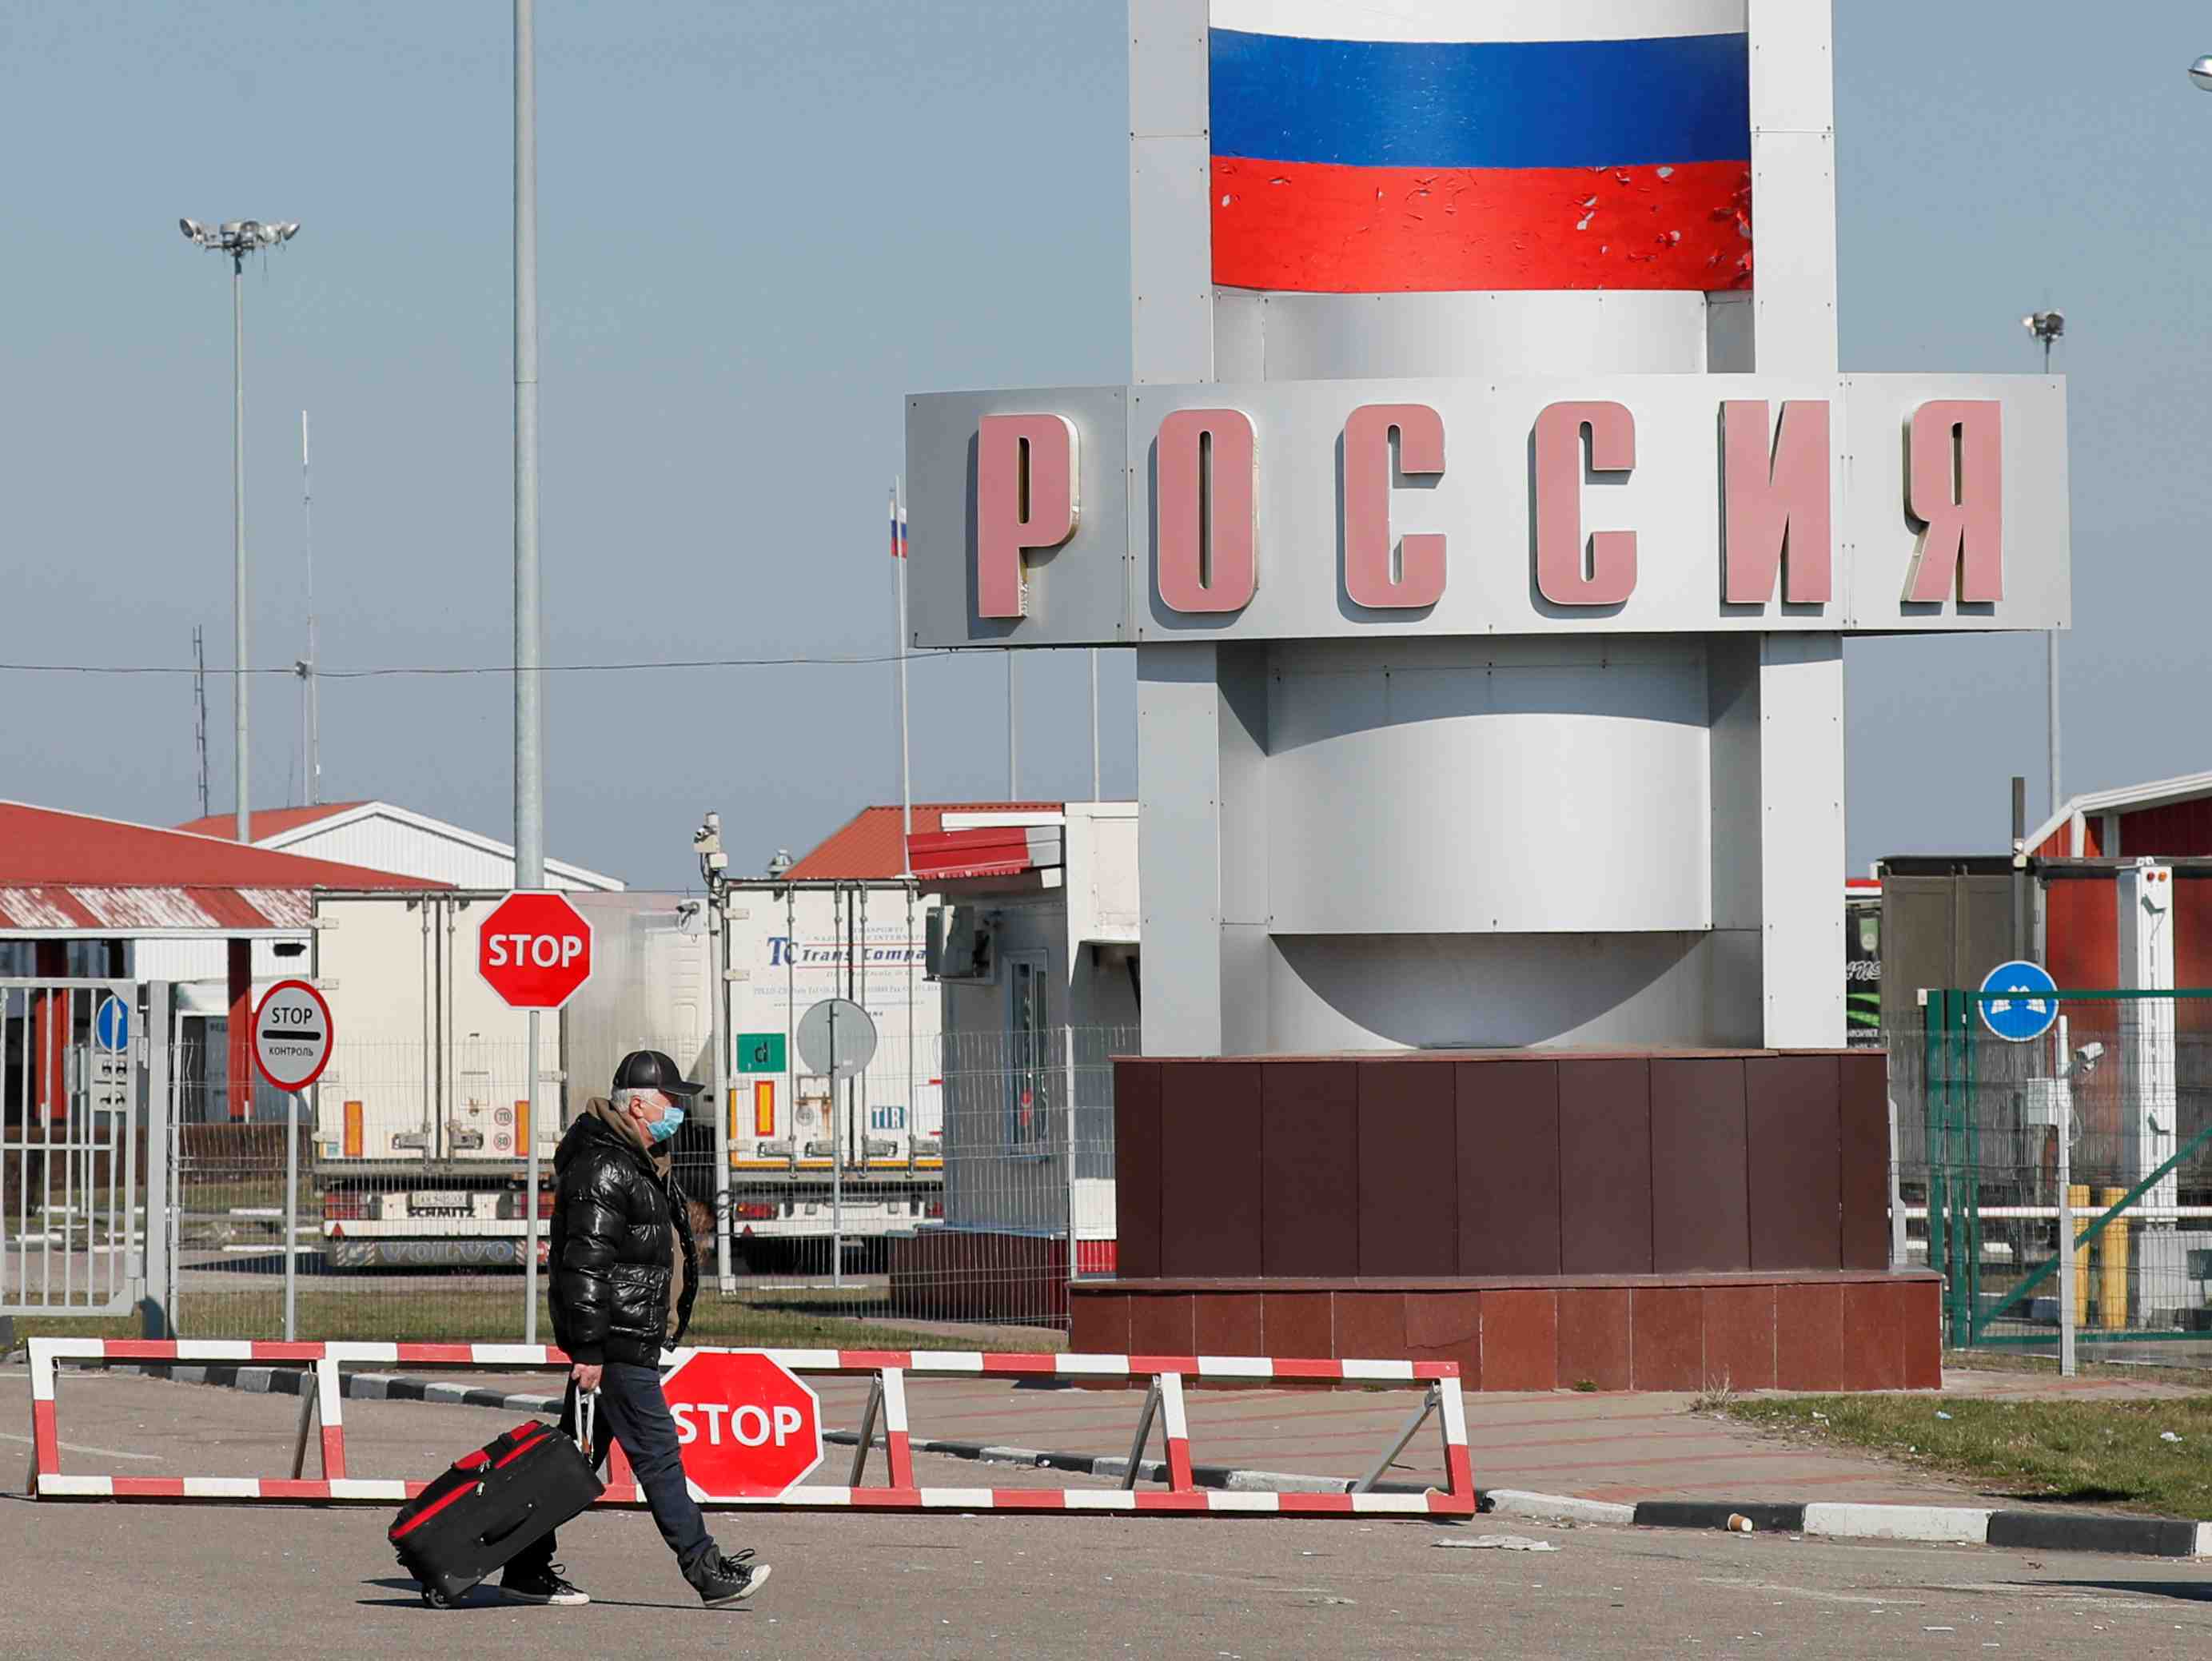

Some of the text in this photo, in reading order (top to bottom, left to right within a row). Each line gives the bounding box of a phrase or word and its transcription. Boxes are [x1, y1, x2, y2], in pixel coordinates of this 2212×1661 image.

[974, 399, 2003, 621] РОССИЯ
[488, 934, 583, 968] STOP
[767, 937, 799, 966] TC
[802, 949, 851, 962] Trans
[272, 1007, 313, 1025] STOP
[269, 1046, 313, 1057] КОНТРОЛЬ
[872, 1106, 904, 1129] TIR
[407, 1207, 476, 1218] SCHMITZ
[377, 1241, 514, 1264] VOLVO
[670, 1403, 803, 1447] STOP
